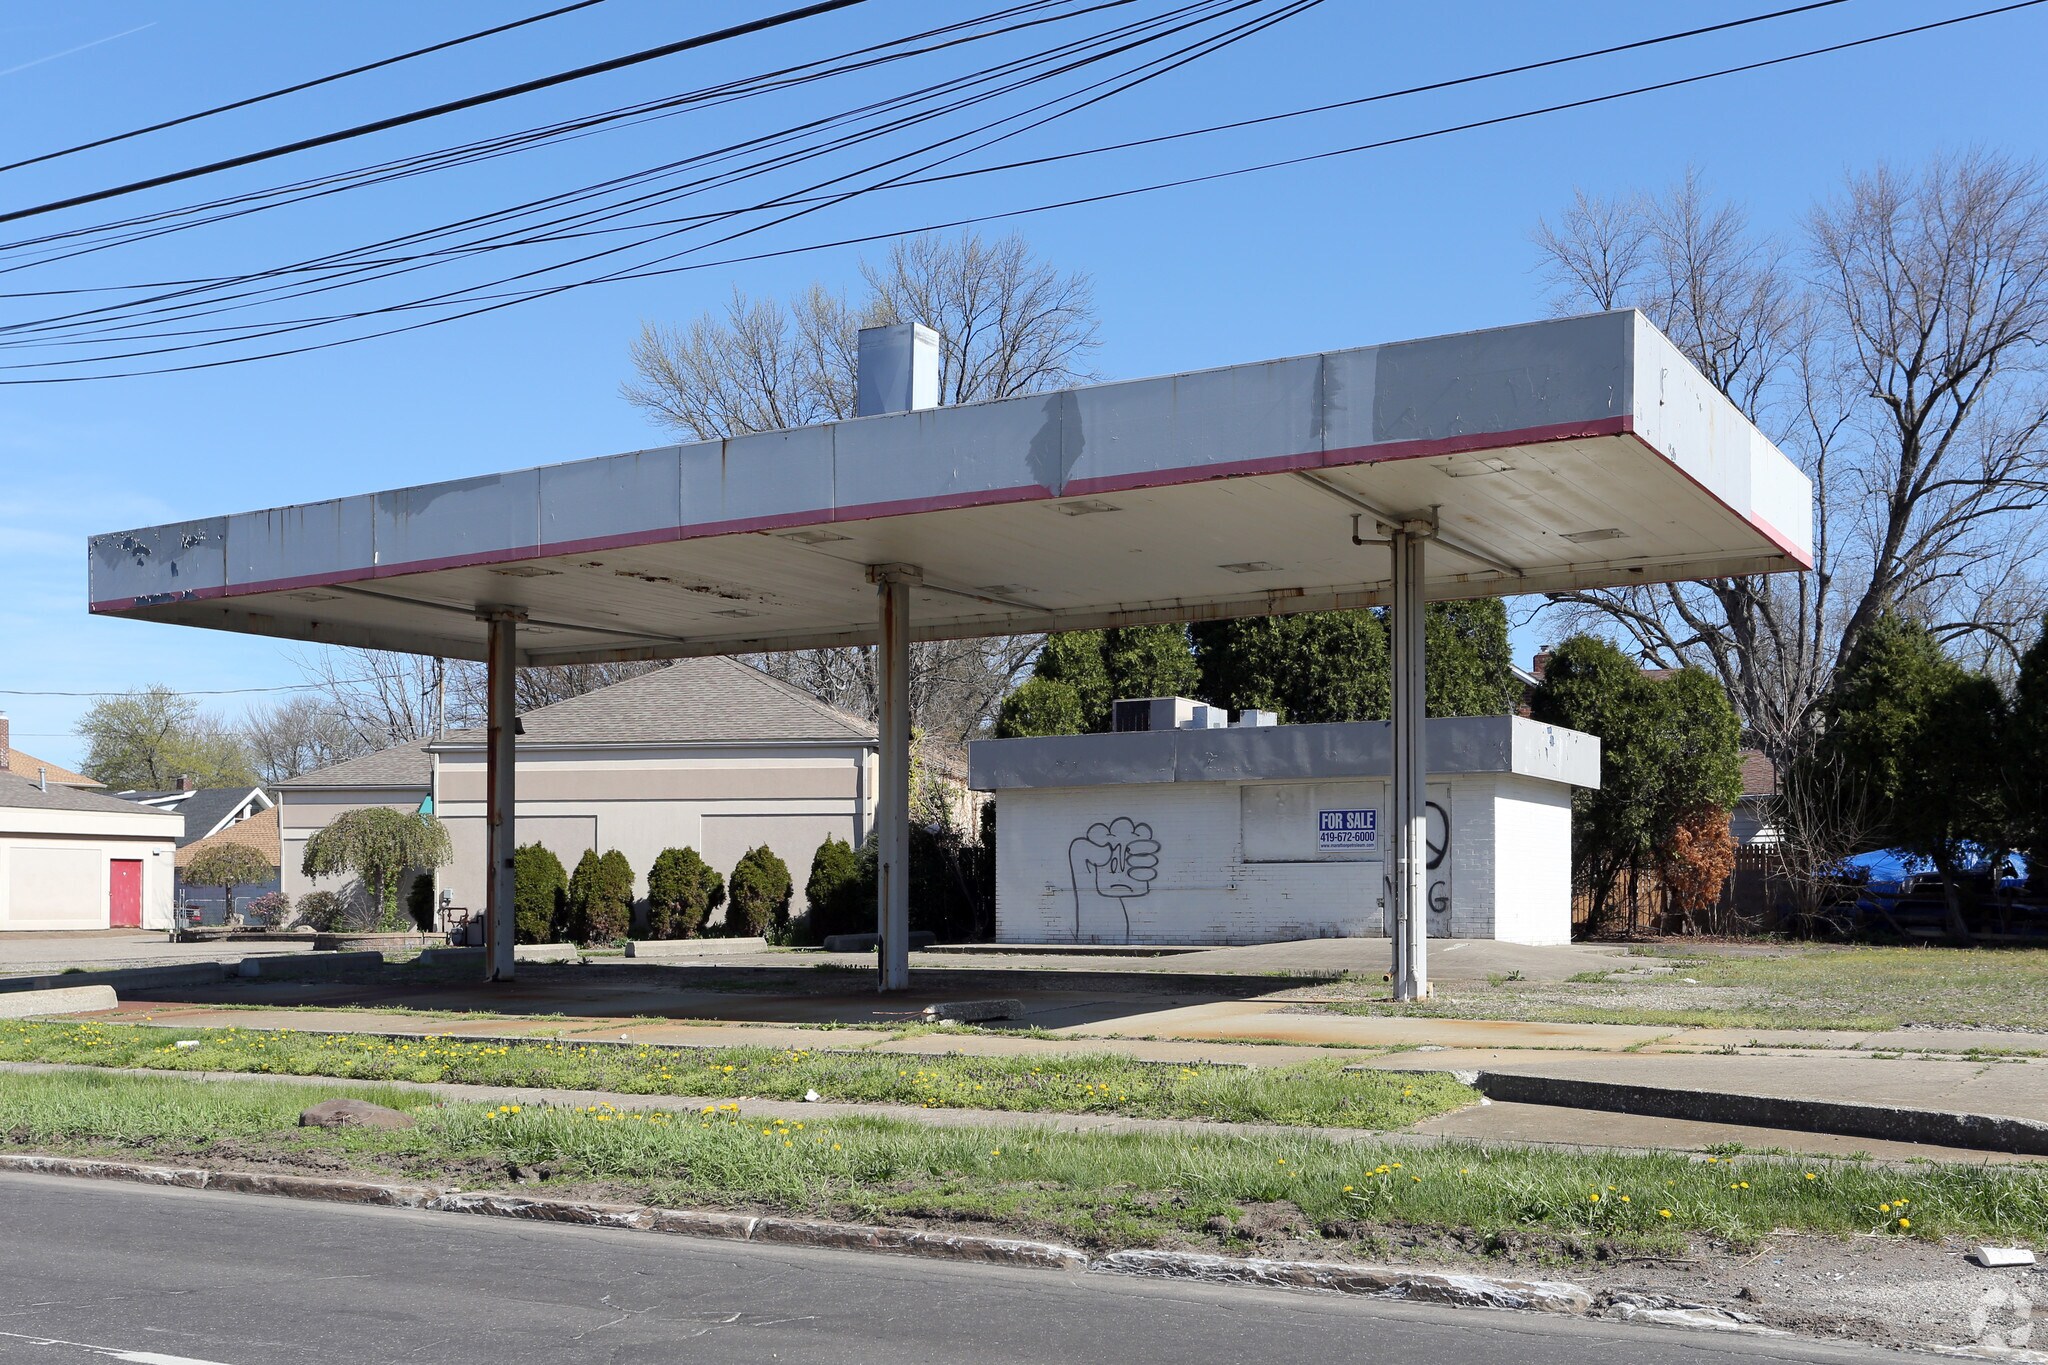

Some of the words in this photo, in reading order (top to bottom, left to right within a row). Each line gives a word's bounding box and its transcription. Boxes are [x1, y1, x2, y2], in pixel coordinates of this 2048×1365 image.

[1321, 812, 1343, 829] FOR
[1346, 811, 1374, 829] SALE
[1320, 831, 1375, 842] 419-672-6000
